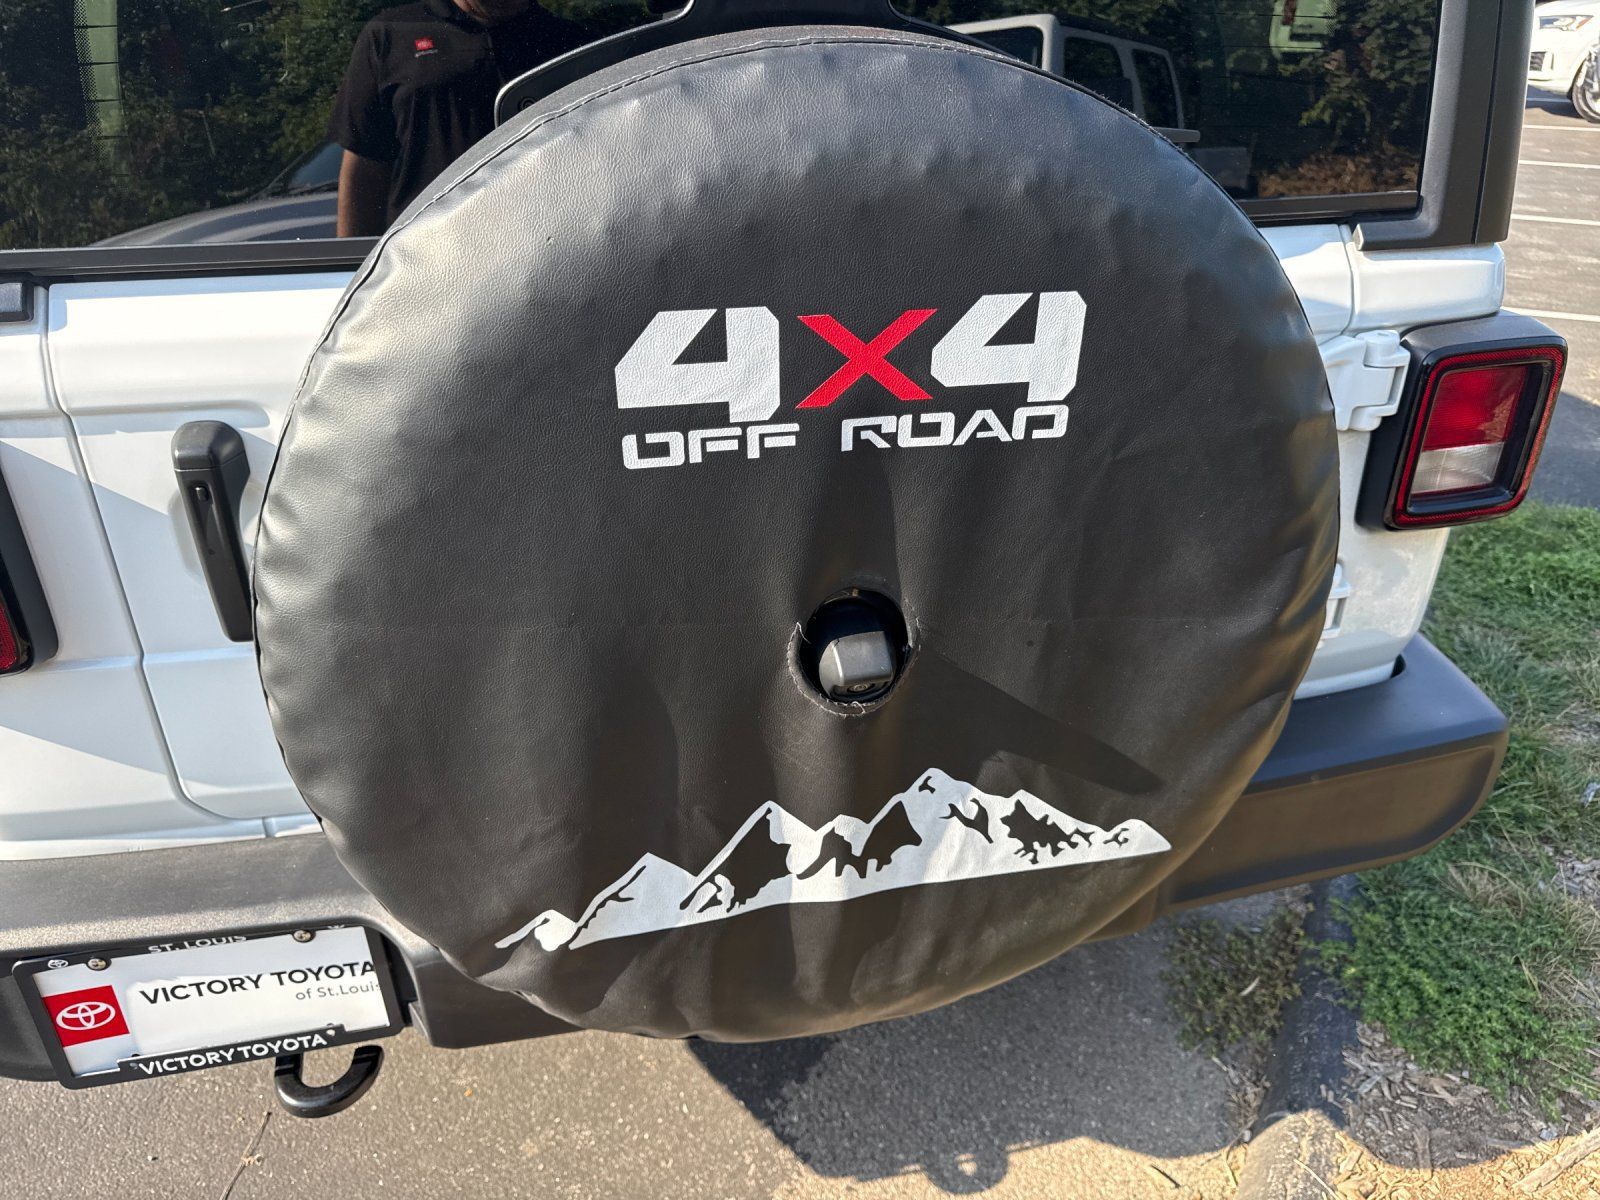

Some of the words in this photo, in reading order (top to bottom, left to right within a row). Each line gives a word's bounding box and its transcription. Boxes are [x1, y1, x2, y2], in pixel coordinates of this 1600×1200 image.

[621, 423, 800, 469] OFF
[841, 405, 1069, 451] ROAD
[147, 942, 181, 954] ST.
[139, 974, 263, 1004] VICTORY
[270, 961, 376, 986] TOYOTA
[295, 988, 311, 1000] of
[138, 1048, 235, 1075] VICTORY
[237, 1034, 327, 1059] TOYOTA
